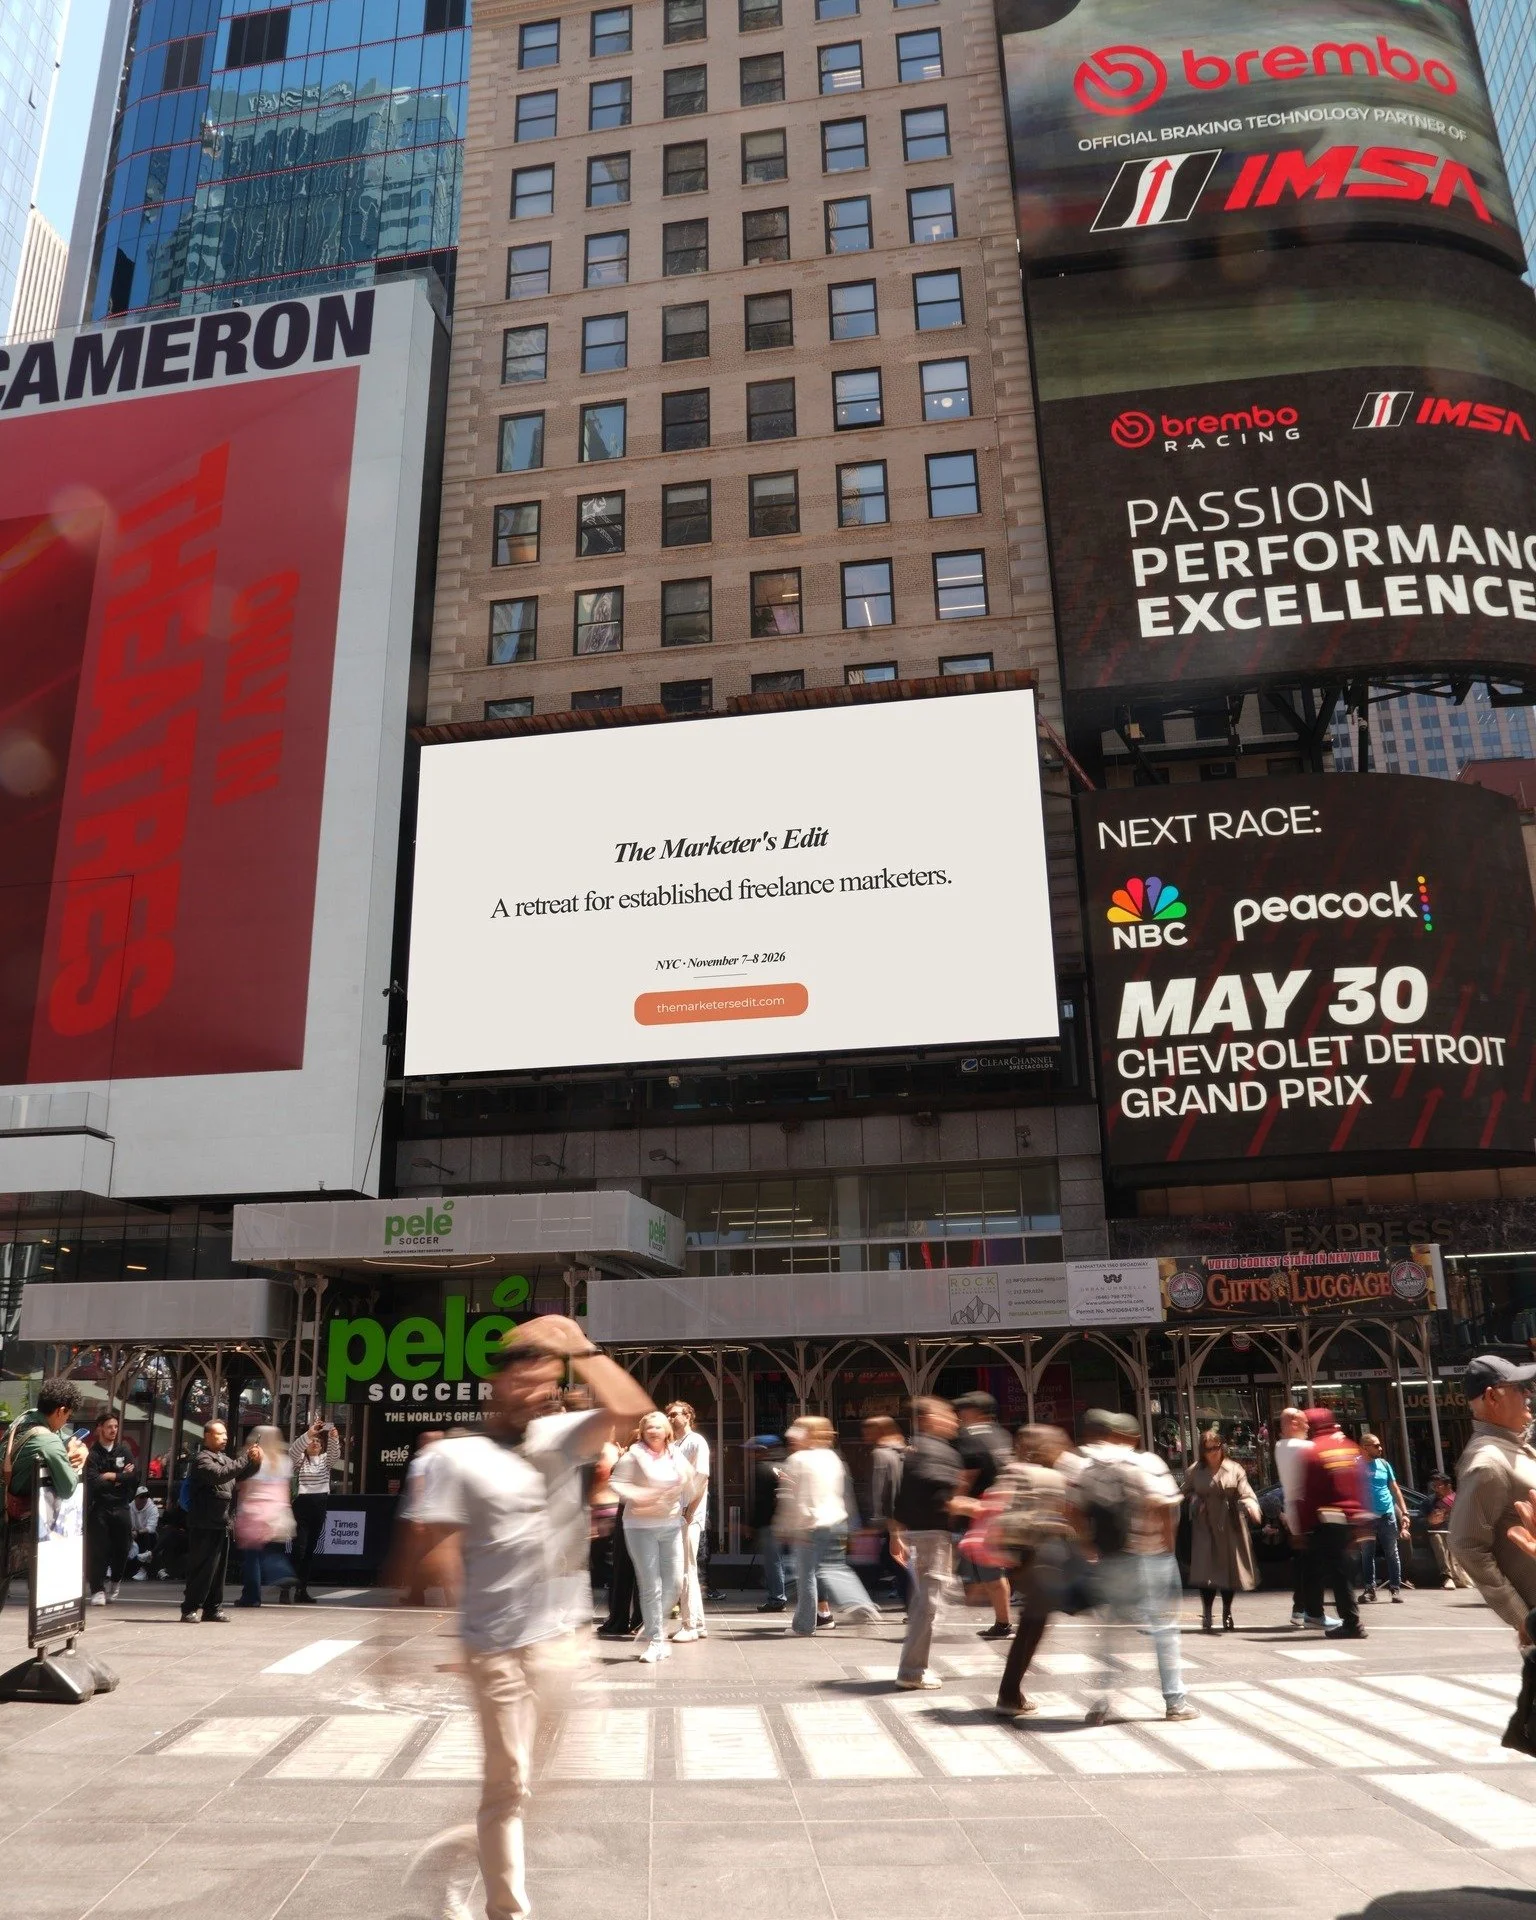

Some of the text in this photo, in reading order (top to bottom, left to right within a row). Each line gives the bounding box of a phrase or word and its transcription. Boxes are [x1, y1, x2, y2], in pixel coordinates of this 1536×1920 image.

[1183, 35, 1457, 96] brembo
[1077, 106, 1468, 152] OFFICIAL BRAKING TECHNOLOGY PARTNER OF
[1223, 145, 1496, 224] IMSA
[0, 288, 376, 410] AMERON
[1161, 405, 1299, 436] brembo
[1164, 427, 1301, 453] RACING
[1415, 396, 1533, 442] IMSA
[1126, 477, 1374, 538] PASSION
[1137, 574, 1536, 639] EXCELLENCE
[214, 570, 300, 807] ONLY IN
[48, 440, 230, 1038] THEATRES
[614, 825, 829, 865] The Marketer's Edit
[1098, 805, 1322, 850] NEXT RACE:
[489, 864, 953, 920] A retreat for established freelance marketers.
[1112, 880, 1418, 951] NBC peacock
[655, 958, 682, 970] NYC
[687, 955, 739, 968] November
[761, 951, 786, 965] 2026
[656, 995, 786, 1014] themarketersedit.com
[1116, 965, 1429, 1039] MAY 30
[1116, 1033, 1506, 1080] CHEVROLET DETROIT
[1120, 1074, 1373, 1119] GRAND PRIX
[384, 1200, 455, 1246] pelé
[398, 1236, 440, 1245] SOCCER
[1283, 1218, 1452, 1251] EXPRESS
[950, 1276, 996, 1288] ROCK
[1207, 1250, 1381, 1271] VOTED COOLEST STORE IN NEW YORK
[1206, 1273, 1272, 1307] GIFTS
[1288, 1270, 1393, 1304] LUGGAGE
[324, 1275, 530, 1404] pelé
[368, 1382, 494, 1402] SOCCER
[385, 1412, 405, 1422] THE
[406, 1411, 452, 1422] WORLD'S
[380, 1444, 410, 1462] pelé
[330, 1528, 360, 1538] Square
[331, 1537, 358, 1546] Alliance
[333, 1519, 358, 1529] Times
